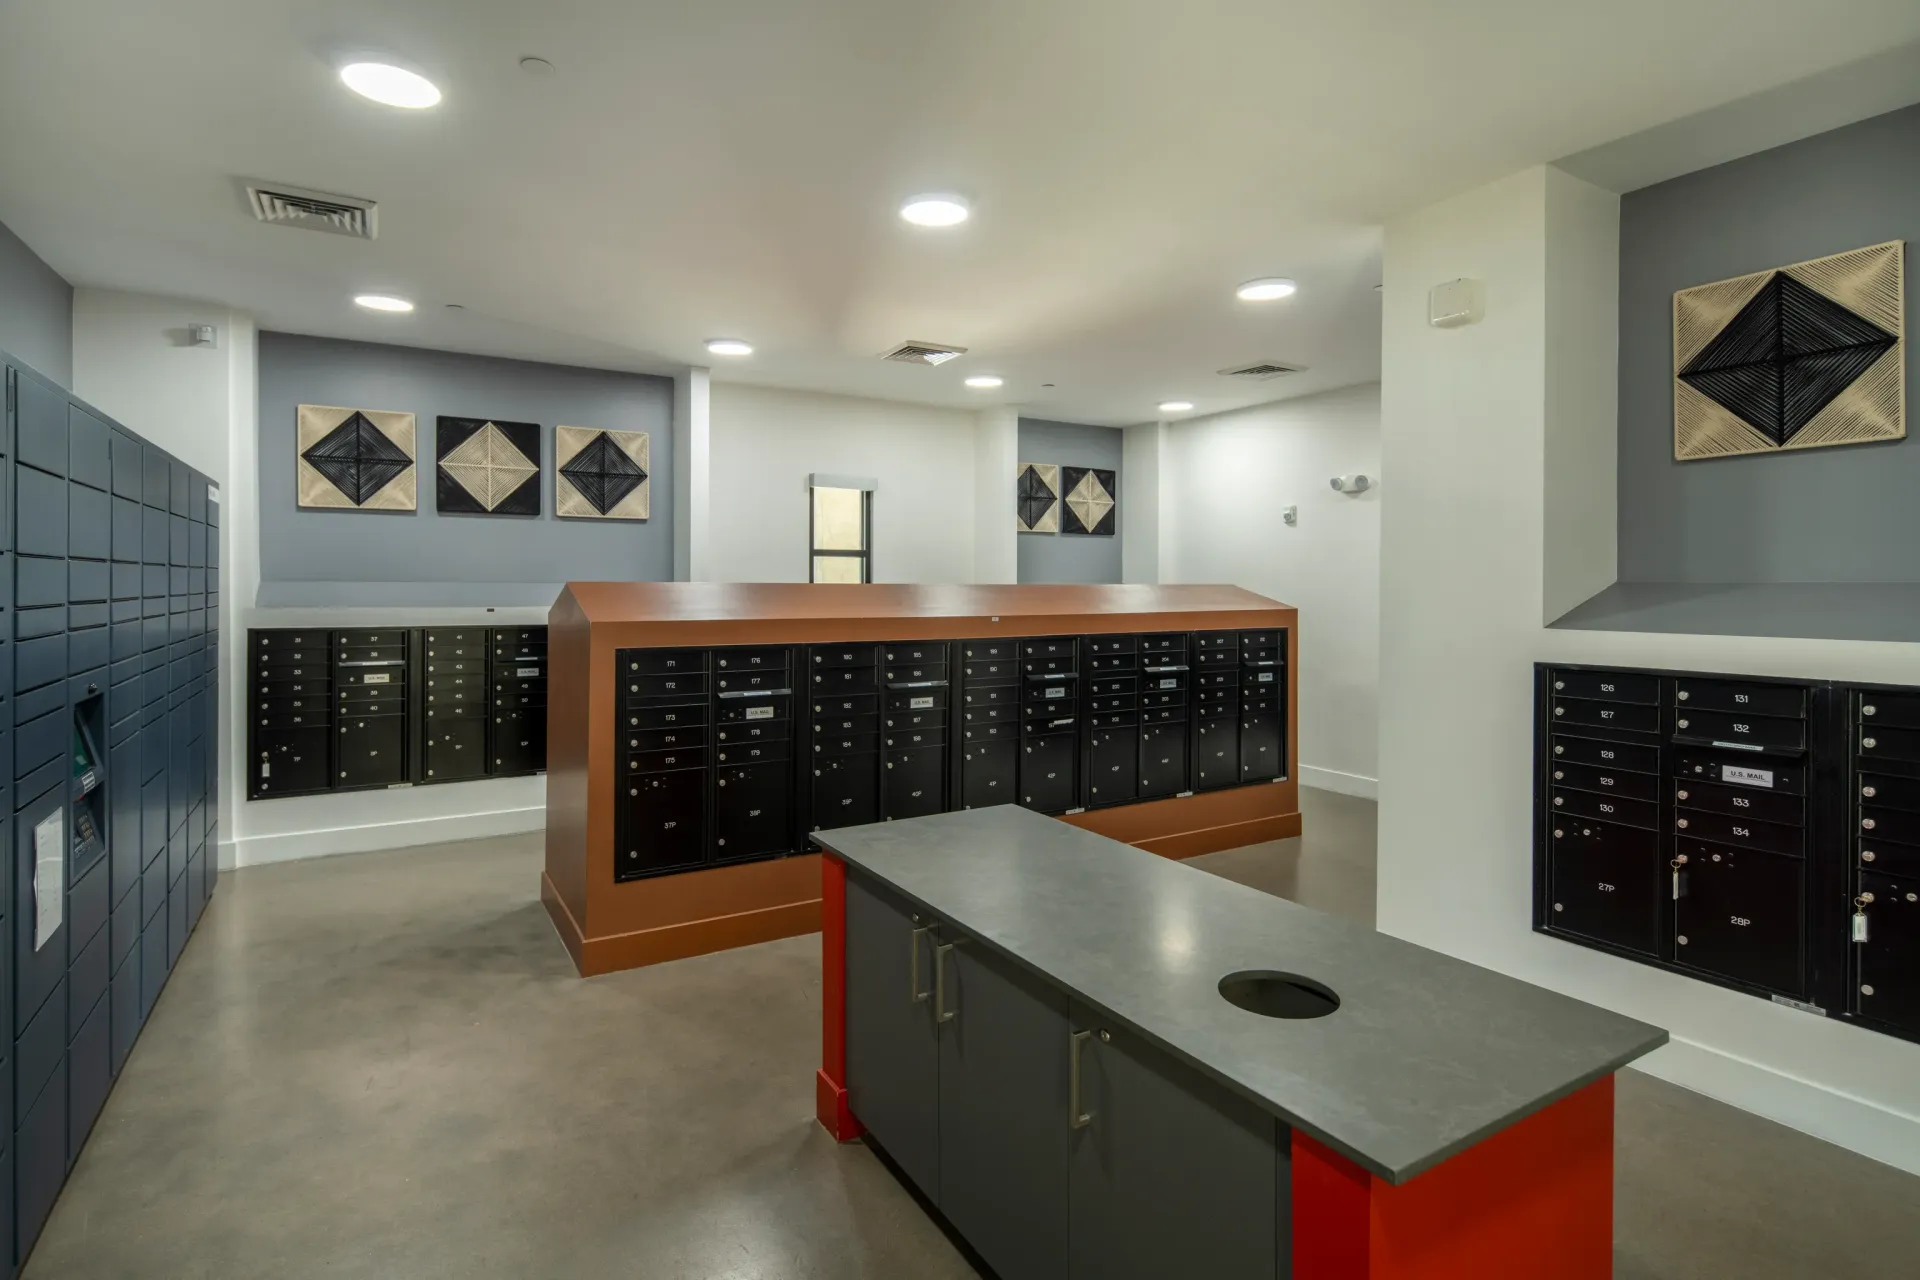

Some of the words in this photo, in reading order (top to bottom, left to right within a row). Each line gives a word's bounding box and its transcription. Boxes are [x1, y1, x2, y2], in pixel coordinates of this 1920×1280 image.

[1600, 683, 1615, 692] 126
[1734, 694, 1749, 704] 131
[1600, 710, 1615, 719] 127
[1732, 723, 1750, 734] 132
[1600, 750, 1615, 759] 128
[1599, 776, 1614, 786] 129
[1747, 772, 1765, 780] MAIL
[1732, 797, 1750, 808] 133
[1599, 803, 1614, 813] 130
[663, 821, 677, 830] 37P
[1732, 826, 1750, 837] 134
[1598, 882, 1616, 893] 27P
[1730, 915, 1751, 927] 28P
